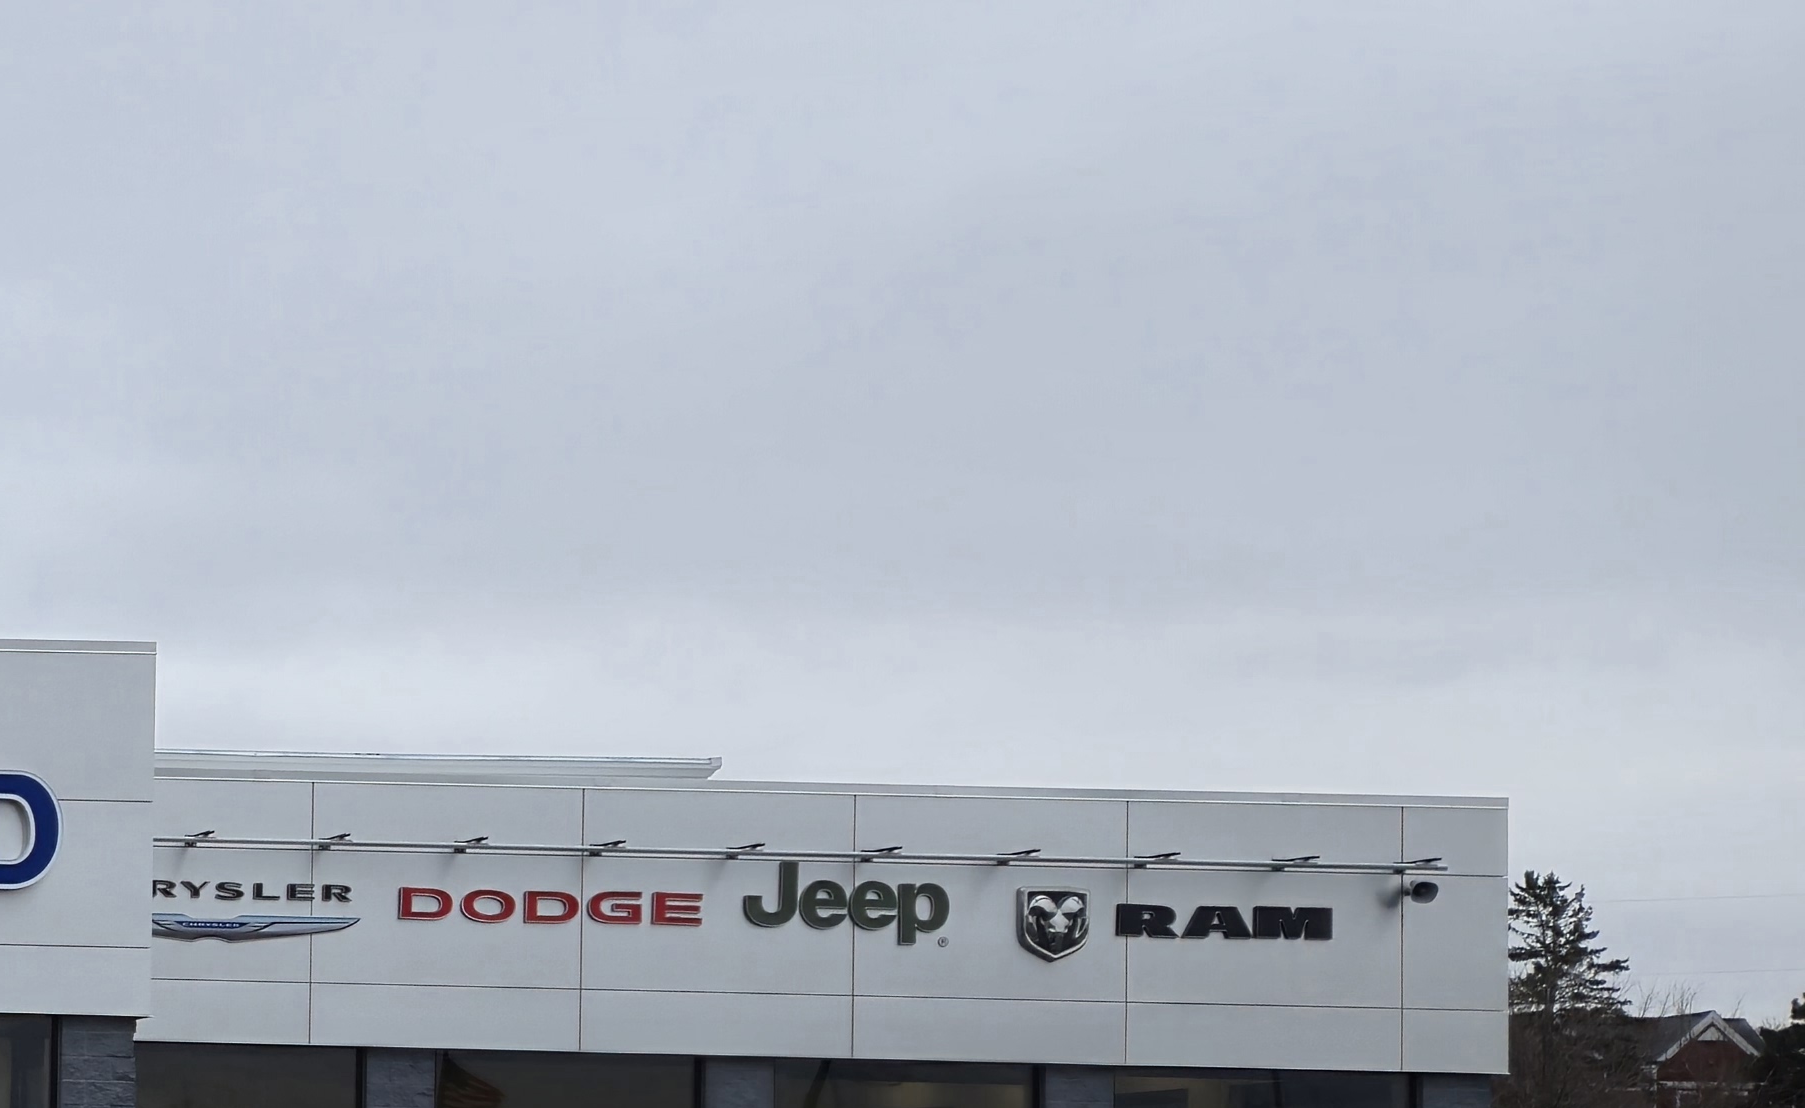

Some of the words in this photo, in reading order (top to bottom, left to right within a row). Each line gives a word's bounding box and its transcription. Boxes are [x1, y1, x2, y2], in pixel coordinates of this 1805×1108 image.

[397, 886, 704, 927] DODGE
[742, 861, 951, 946] Jeep
[1115, 903, 1334, 941] RAM
